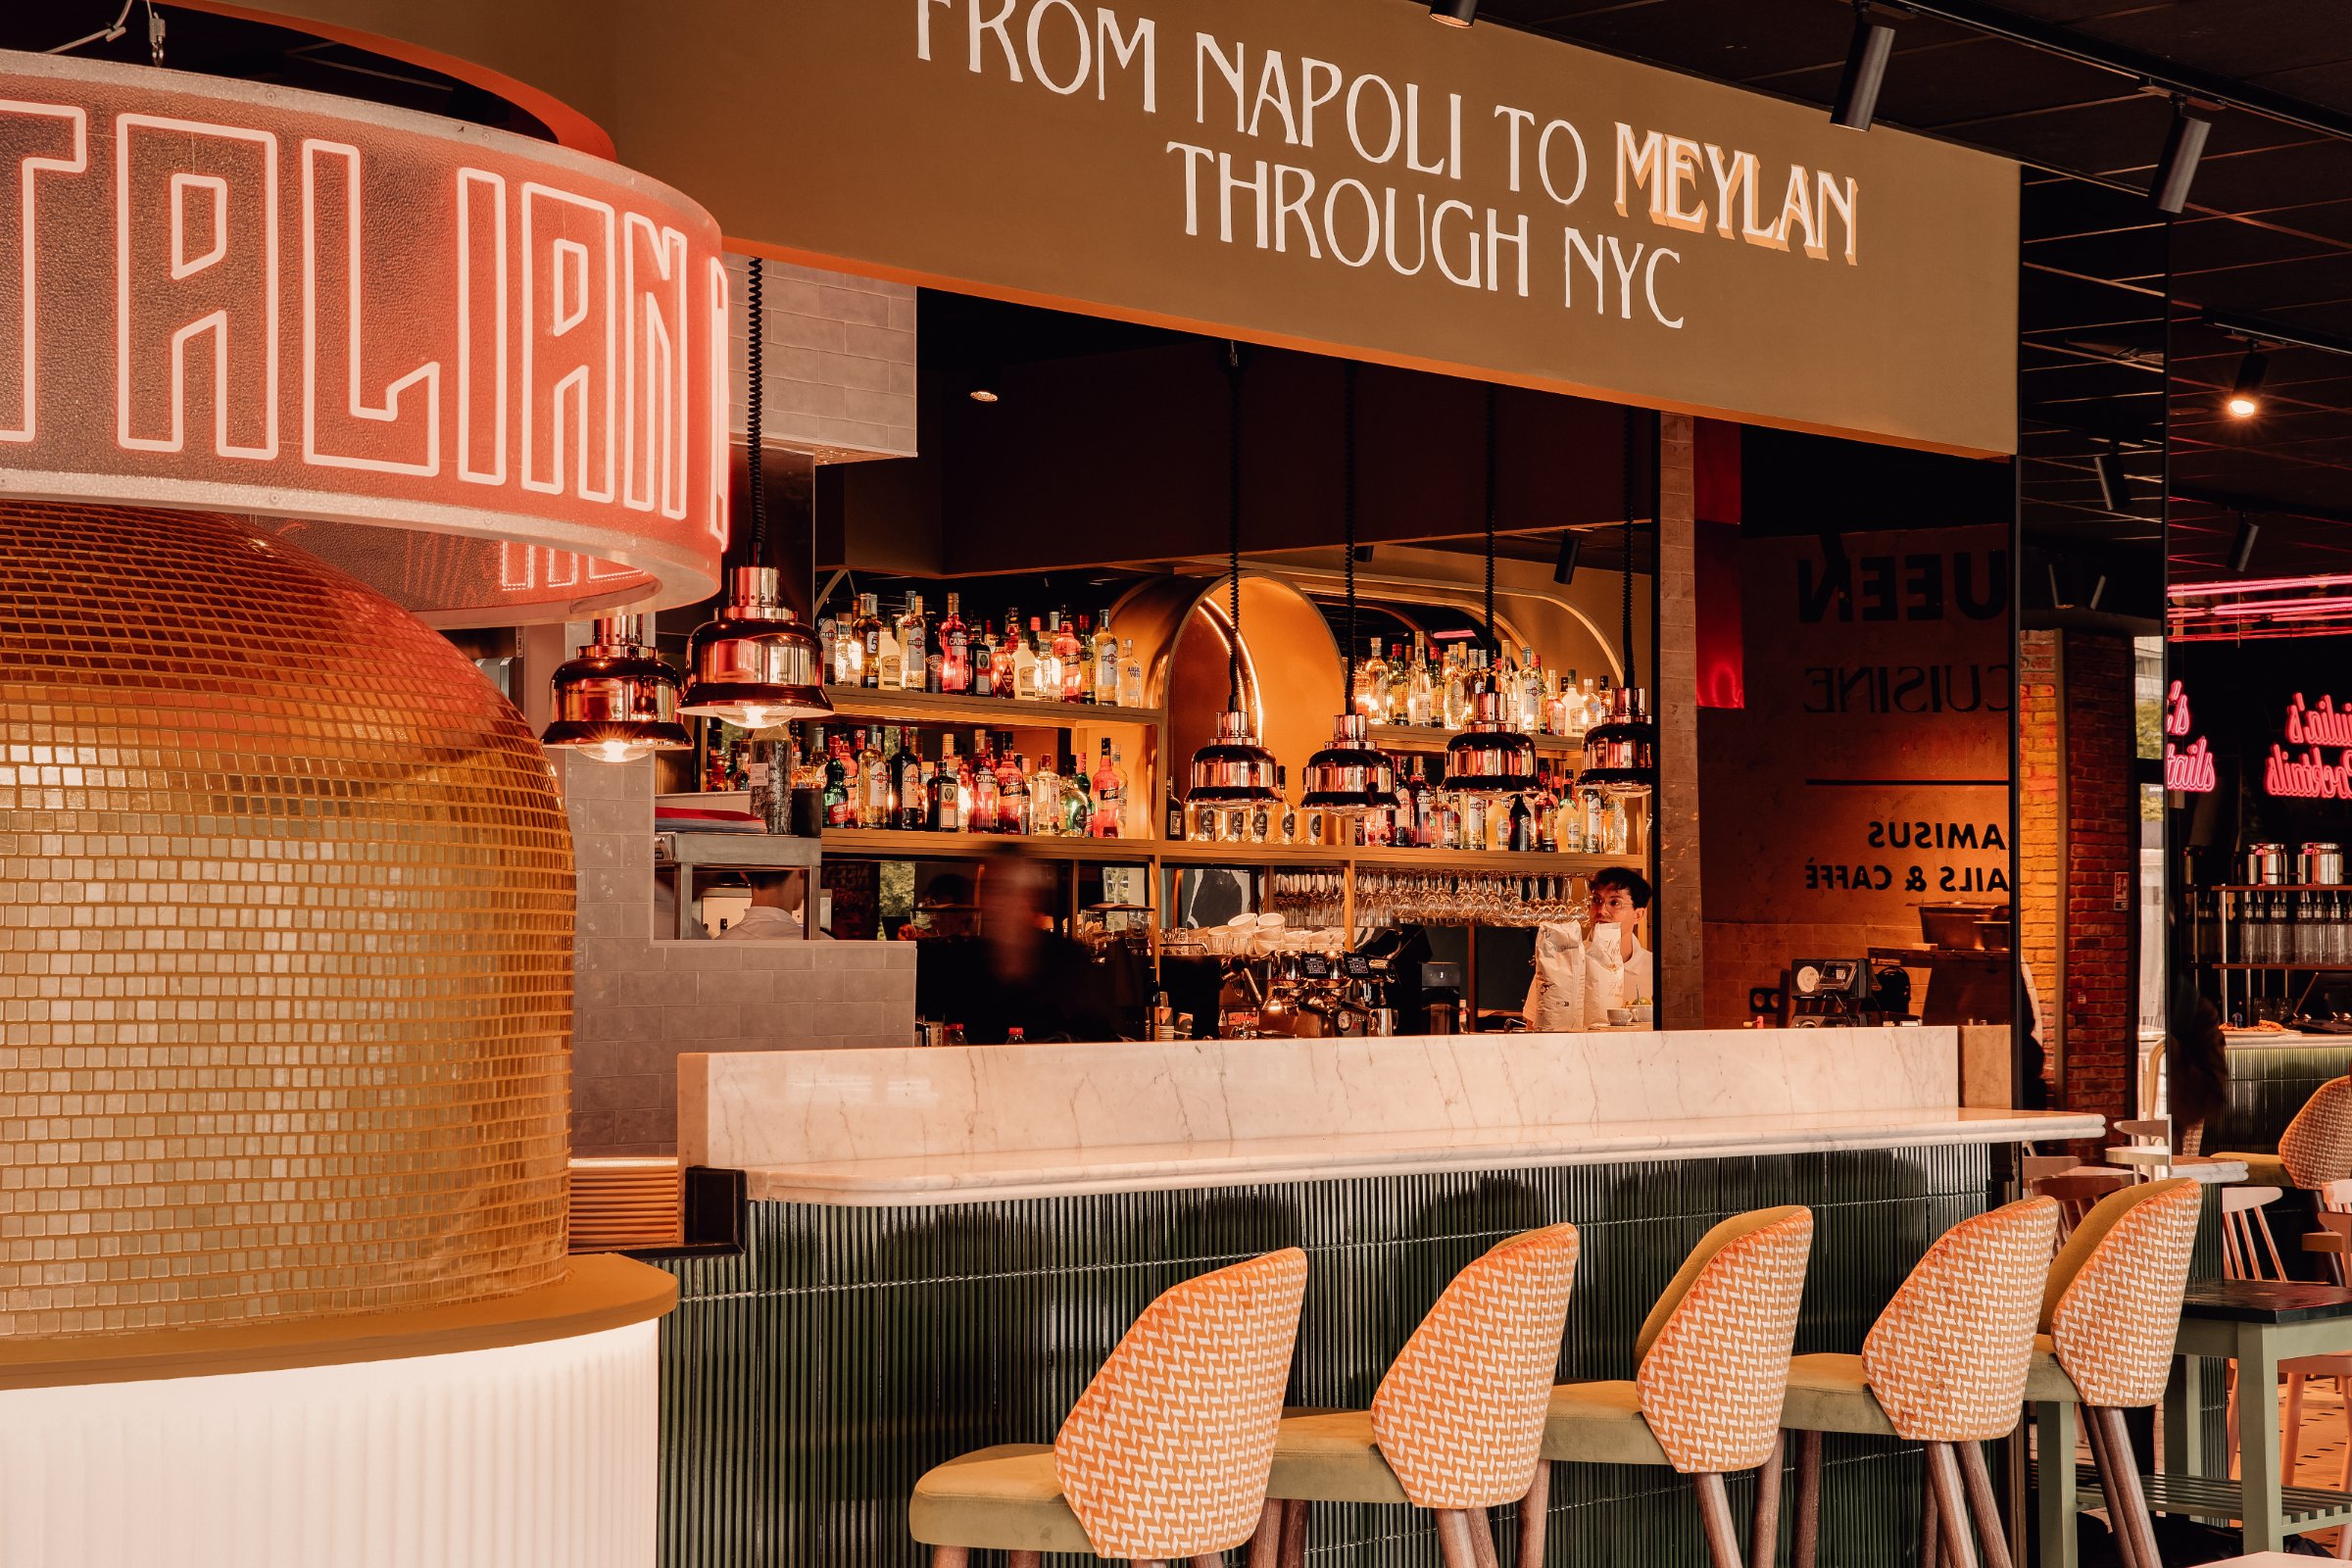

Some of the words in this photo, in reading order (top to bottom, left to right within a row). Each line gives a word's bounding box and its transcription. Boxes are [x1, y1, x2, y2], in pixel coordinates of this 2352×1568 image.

[1166, 140, 1530, 298] THROUGH
[1564, 226, 1685, 329] NYC
[1196, 31, 1462, 180] NAPOLI
[1494, 104, 1588, 206] TO
[1614, 121, 1859, 267] MEYLAN
